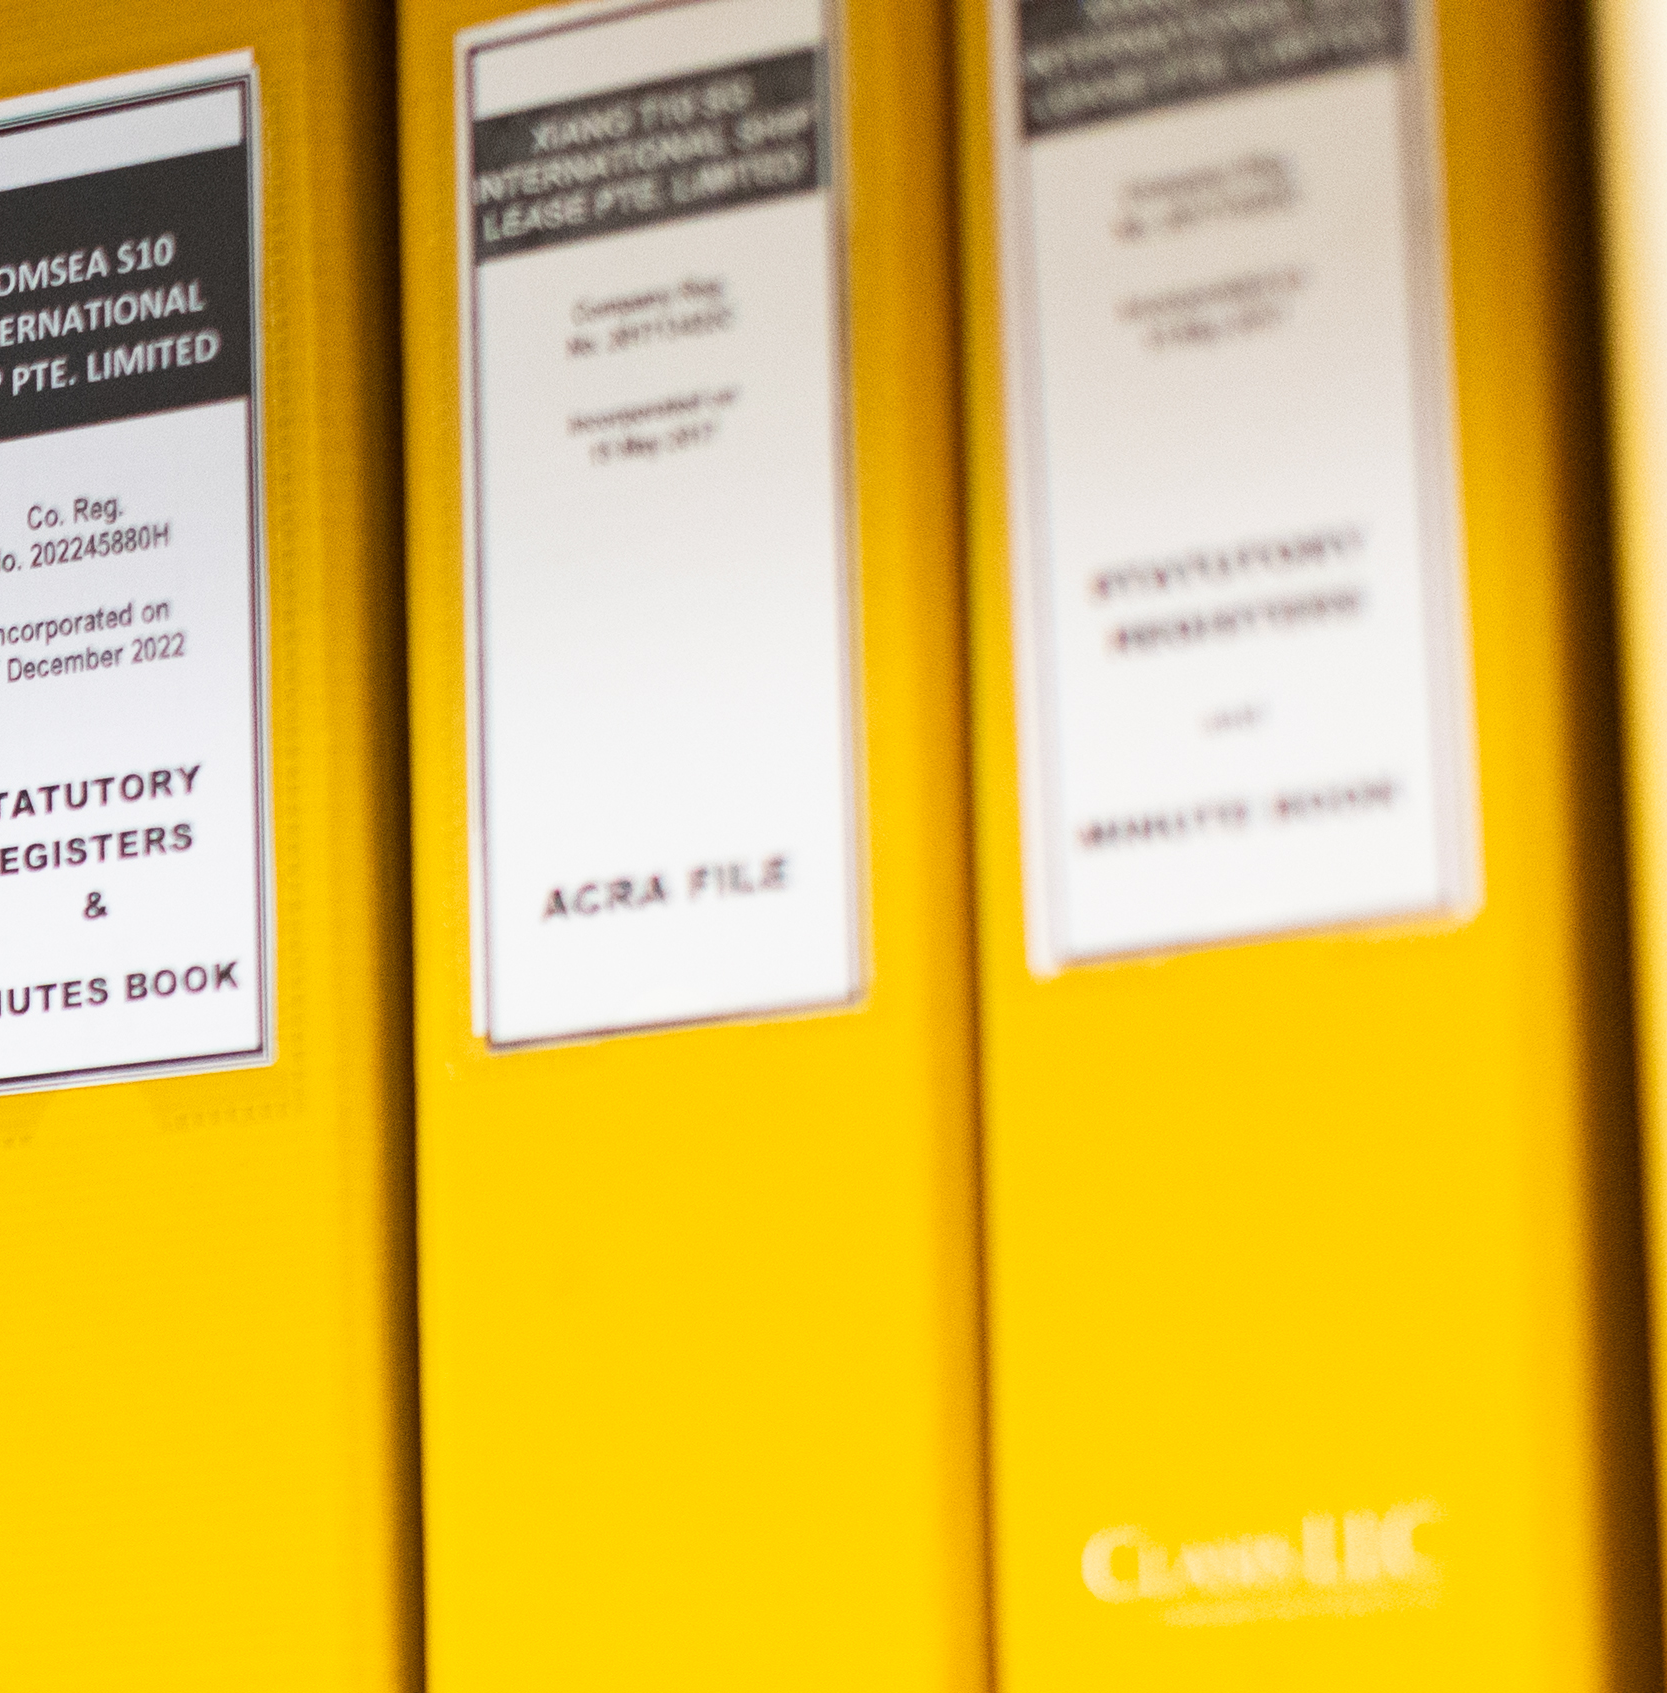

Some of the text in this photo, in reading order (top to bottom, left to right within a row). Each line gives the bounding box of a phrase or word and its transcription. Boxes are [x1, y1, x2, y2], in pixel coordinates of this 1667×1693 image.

[481, 194, 587, 242] LEASE
[117, 232, 176, 274] S10
[12, 361, 76, 397] PTE.
[87, 329, 222, 384] LIMITED
[26, 497, 124, 531] Co. Reg.
[29, 522, 170, 569] 202245880H
[141, 600, 170, 624] on
[7, 646, 123, 683] December
[130, 631, 186, 665] 2022
[82, 891, 108, 920] &
[543, 854, 788, 922] ACRA FILE
[125, 961, 240, 1002] BOOK
